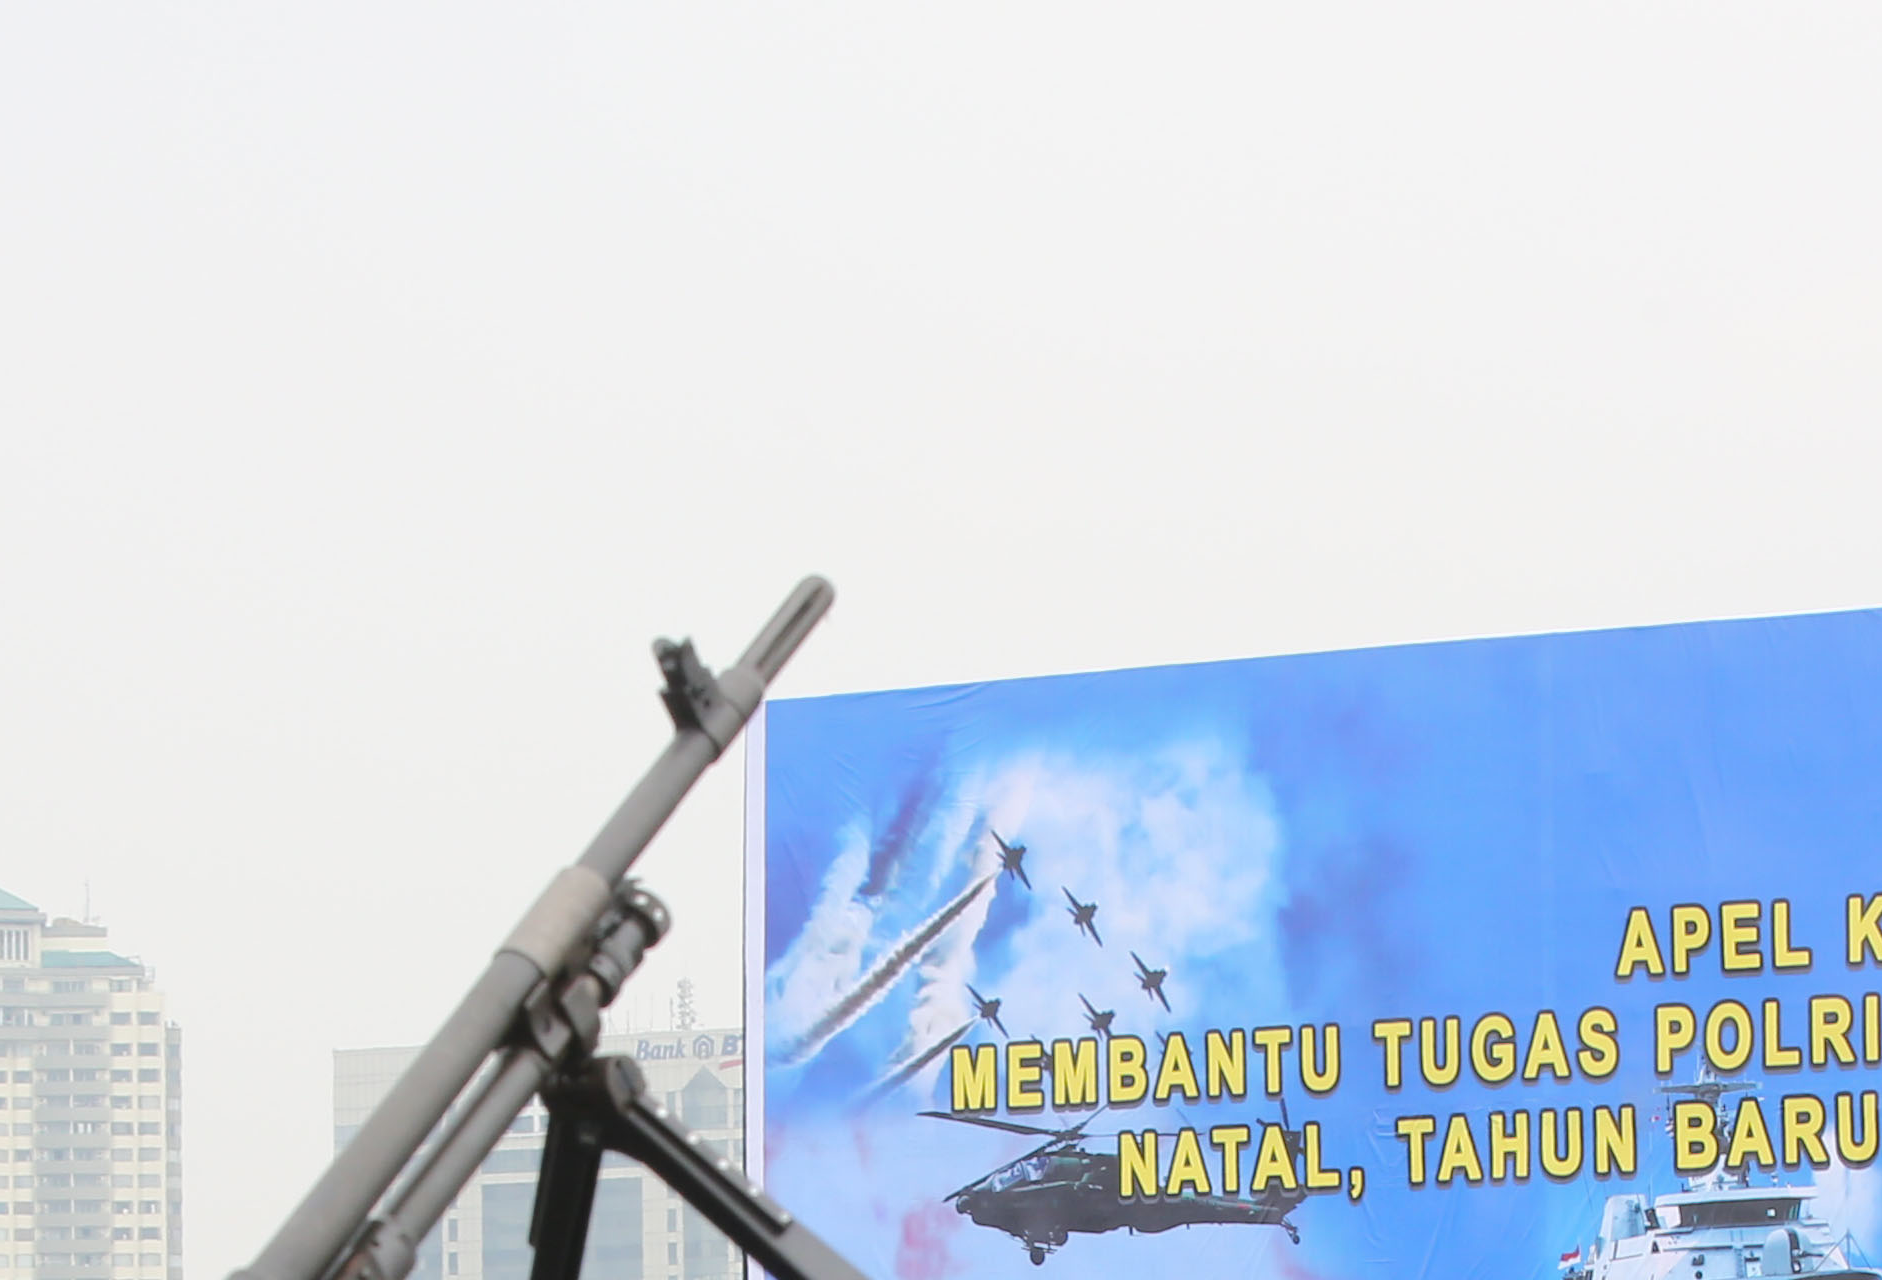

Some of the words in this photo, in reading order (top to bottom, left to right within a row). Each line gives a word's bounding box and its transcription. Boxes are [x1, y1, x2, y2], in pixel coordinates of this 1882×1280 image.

[1616, 900, 1812, 977] APEL
[636, 1038, 685, 1060] Bank
[951, 1024, 1340, 1111] MEMBANTU
[1372, 1008, 1619, 1088] TUGAS
[1655, 994, 1881, 1073] POLRI
[1118, 1122, 1364, 1199] NATAL,
[1396, 1106, 1637, 1184] TAHUN
